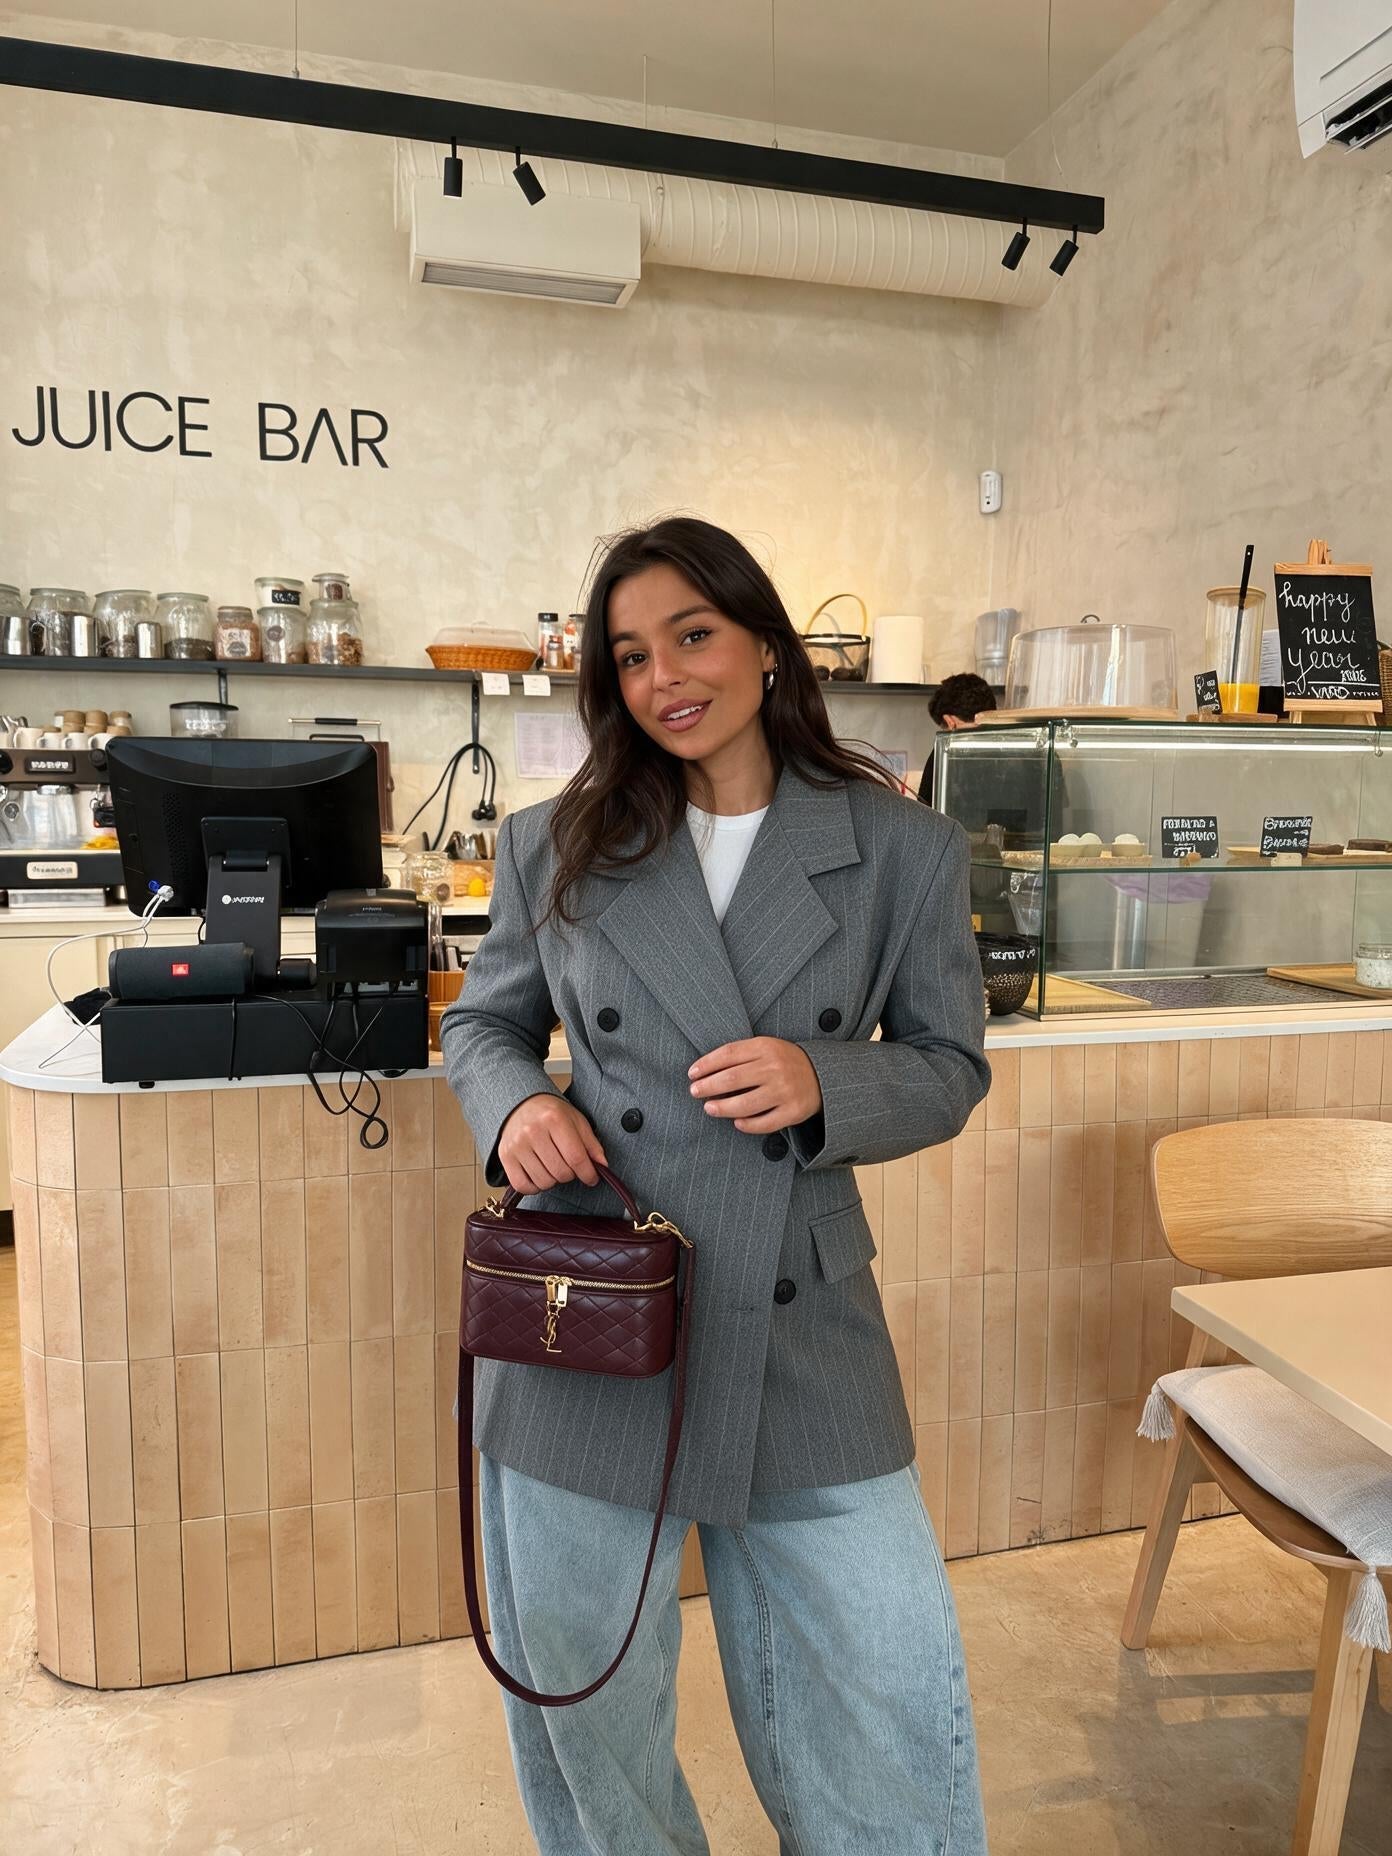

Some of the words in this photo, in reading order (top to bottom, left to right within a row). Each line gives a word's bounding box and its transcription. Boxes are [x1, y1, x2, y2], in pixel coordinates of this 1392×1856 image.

[11, 385, 213, 458] JUICE
[257, 402, 390, 469] BAR
[1278, 581, 1356, 623] happy
[1301, 626, 1357, 645] new
